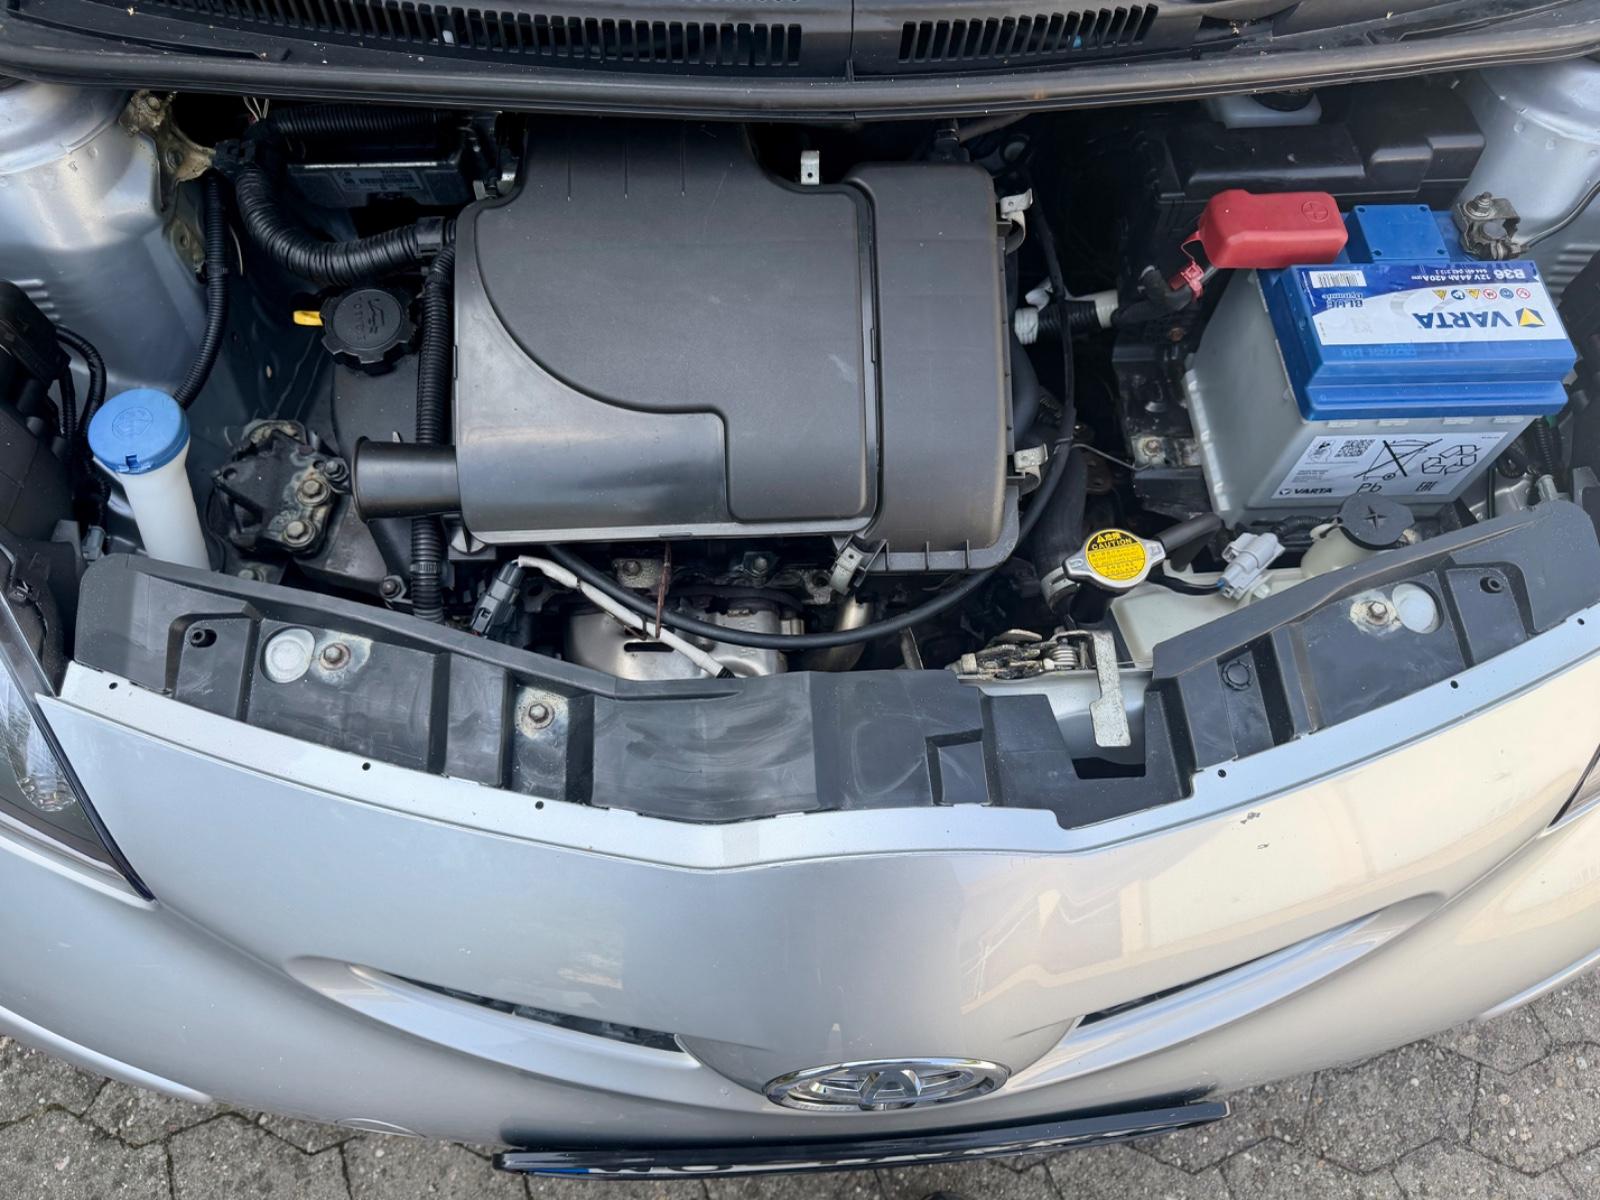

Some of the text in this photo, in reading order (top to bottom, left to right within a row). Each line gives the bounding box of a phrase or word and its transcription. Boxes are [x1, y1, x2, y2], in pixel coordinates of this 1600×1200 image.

[1494, 268, 1526, 280] B36
[1326, 299, 1364, 309] BLUE
[1412, 311, 1513, 329] VARTA
[1294, 487, 1333, 495] VARTA
[1356, 483, 1383, 494] Pb
[1091, 538, 1133, 550] CAUTION
